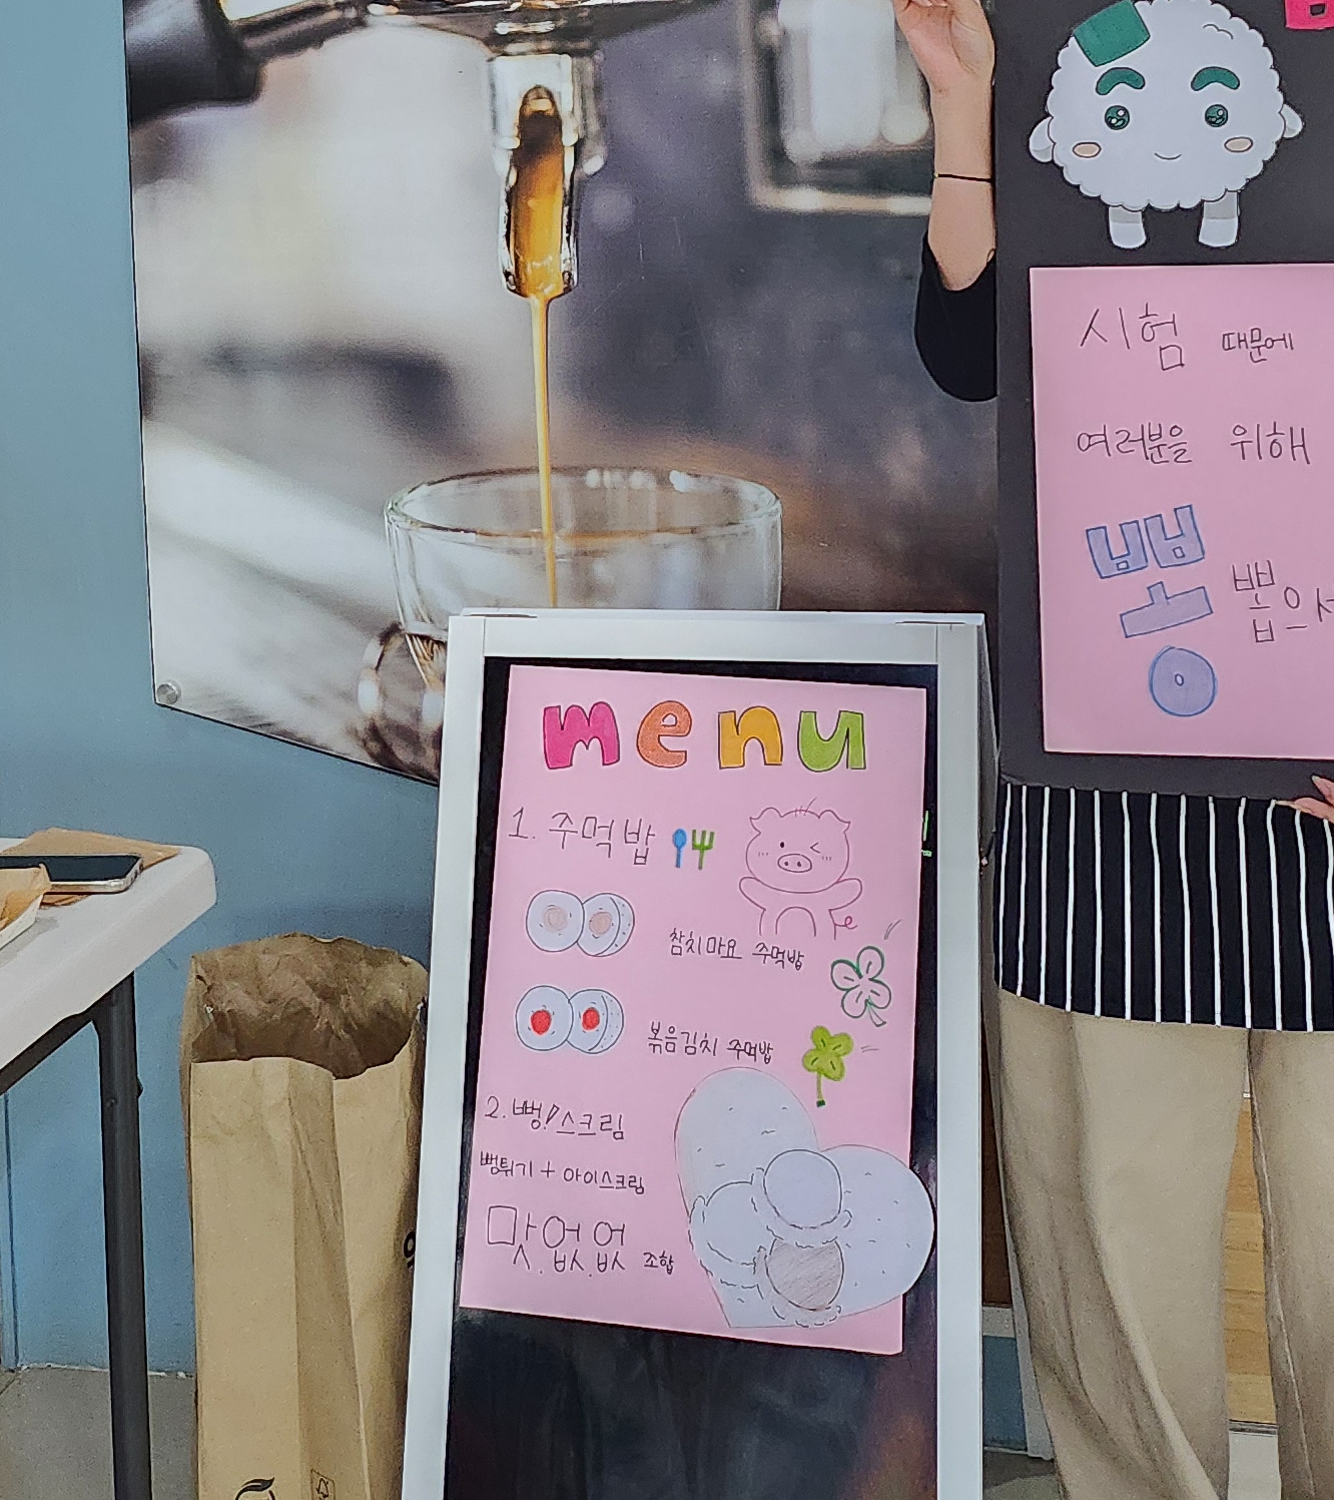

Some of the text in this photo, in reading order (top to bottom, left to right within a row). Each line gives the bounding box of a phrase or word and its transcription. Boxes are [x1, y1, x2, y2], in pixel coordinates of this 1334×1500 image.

[1079, 302, 1185, 371] 시험
[1221, 329, 1295, 364] 때문에
[1077, 422, 1193, 466] 여러분을
[1230, 419, 1311, 466] 위해
[542, 700, 867, 773] menu
[549, 811, 656, 866] 주먹밥
[669, 927, 805, 971] 참치마요 주먹밥
[647, 1020, 774, 1065] 볶음김치 주먹밥
[479, 1150, 533, 1178] 뻥튀기
[563, 1166, 645, 1195] 아이스크림
[643, 1250, 675, 1276] 조합
